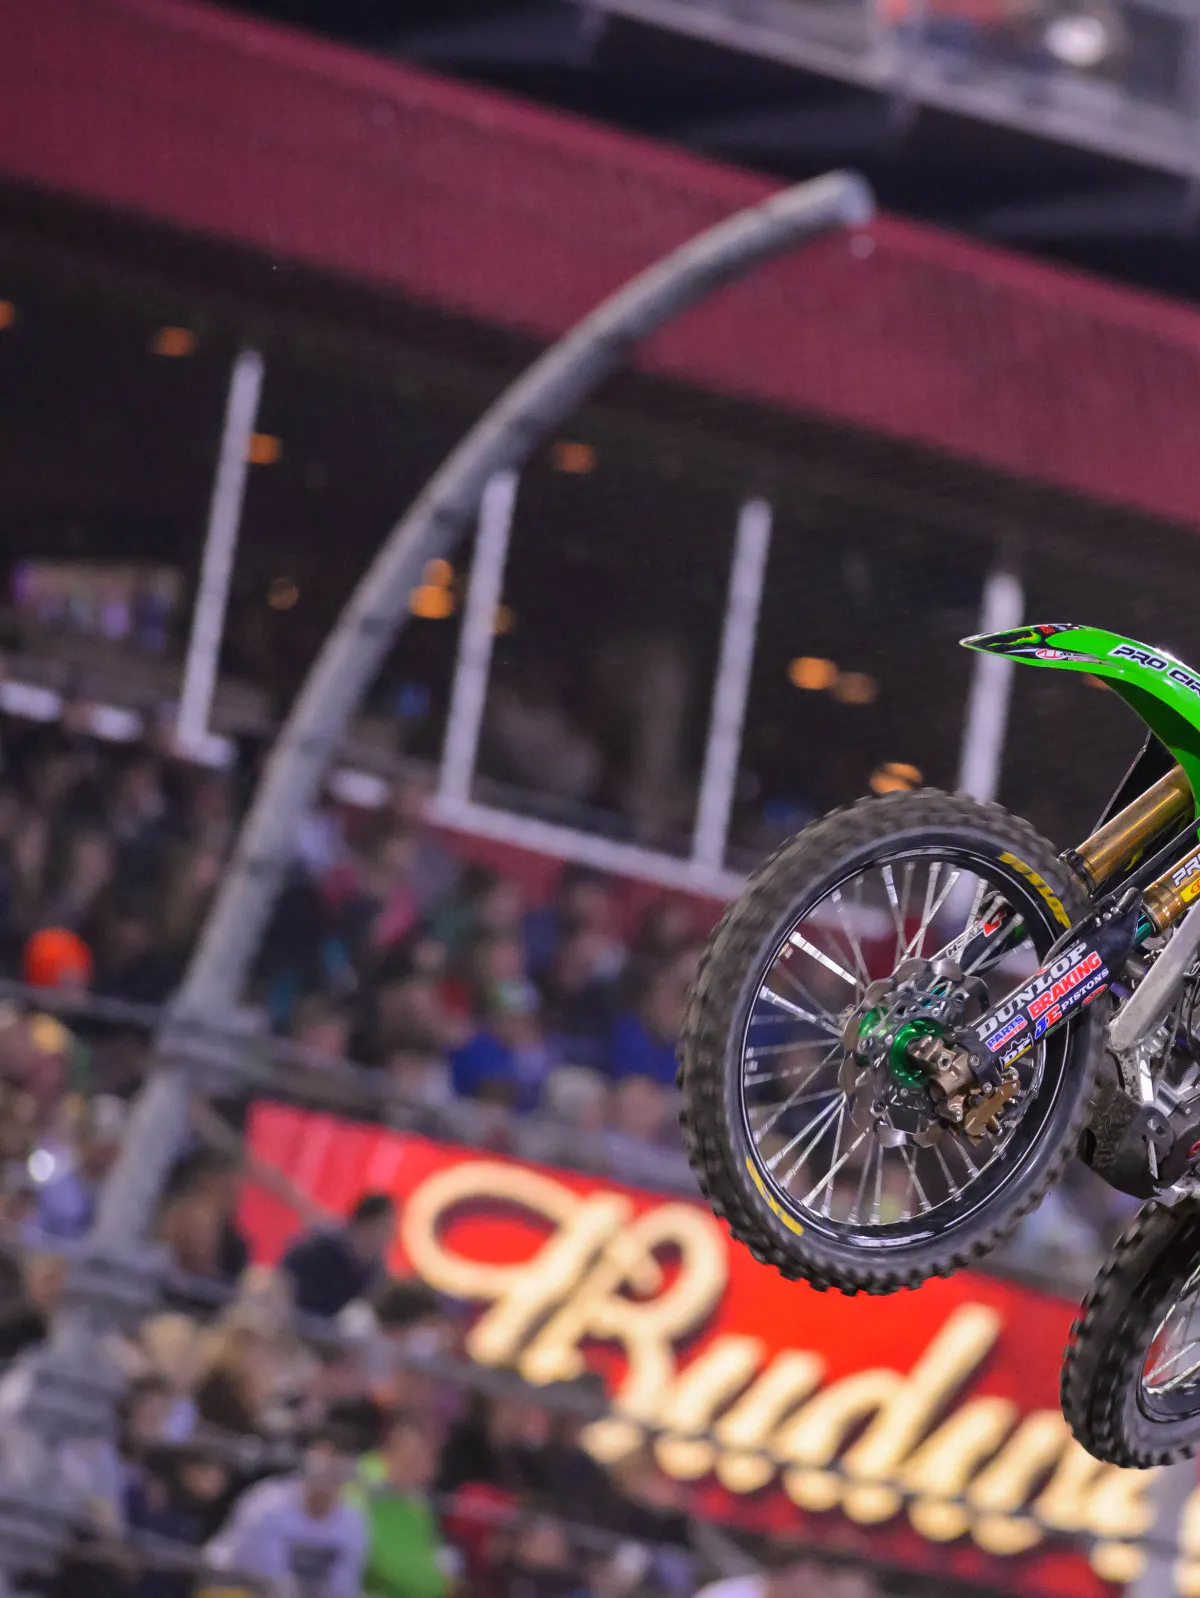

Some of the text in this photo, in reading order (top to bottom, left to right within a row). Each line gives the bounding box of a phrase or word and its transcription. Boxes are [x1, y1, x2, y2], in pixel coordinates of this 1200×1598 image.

[1109, 644, 1168, 672] PRO
[976, 942, 1087, 1041] DUNLOP
[1027, 951, 1103, 1020] BRAKING
[1034, 1004, 1062, 1040] JE
[1060, 968, 1110, 1011] PISTONS
[986, 1015, 1025, 1047] PARTS
